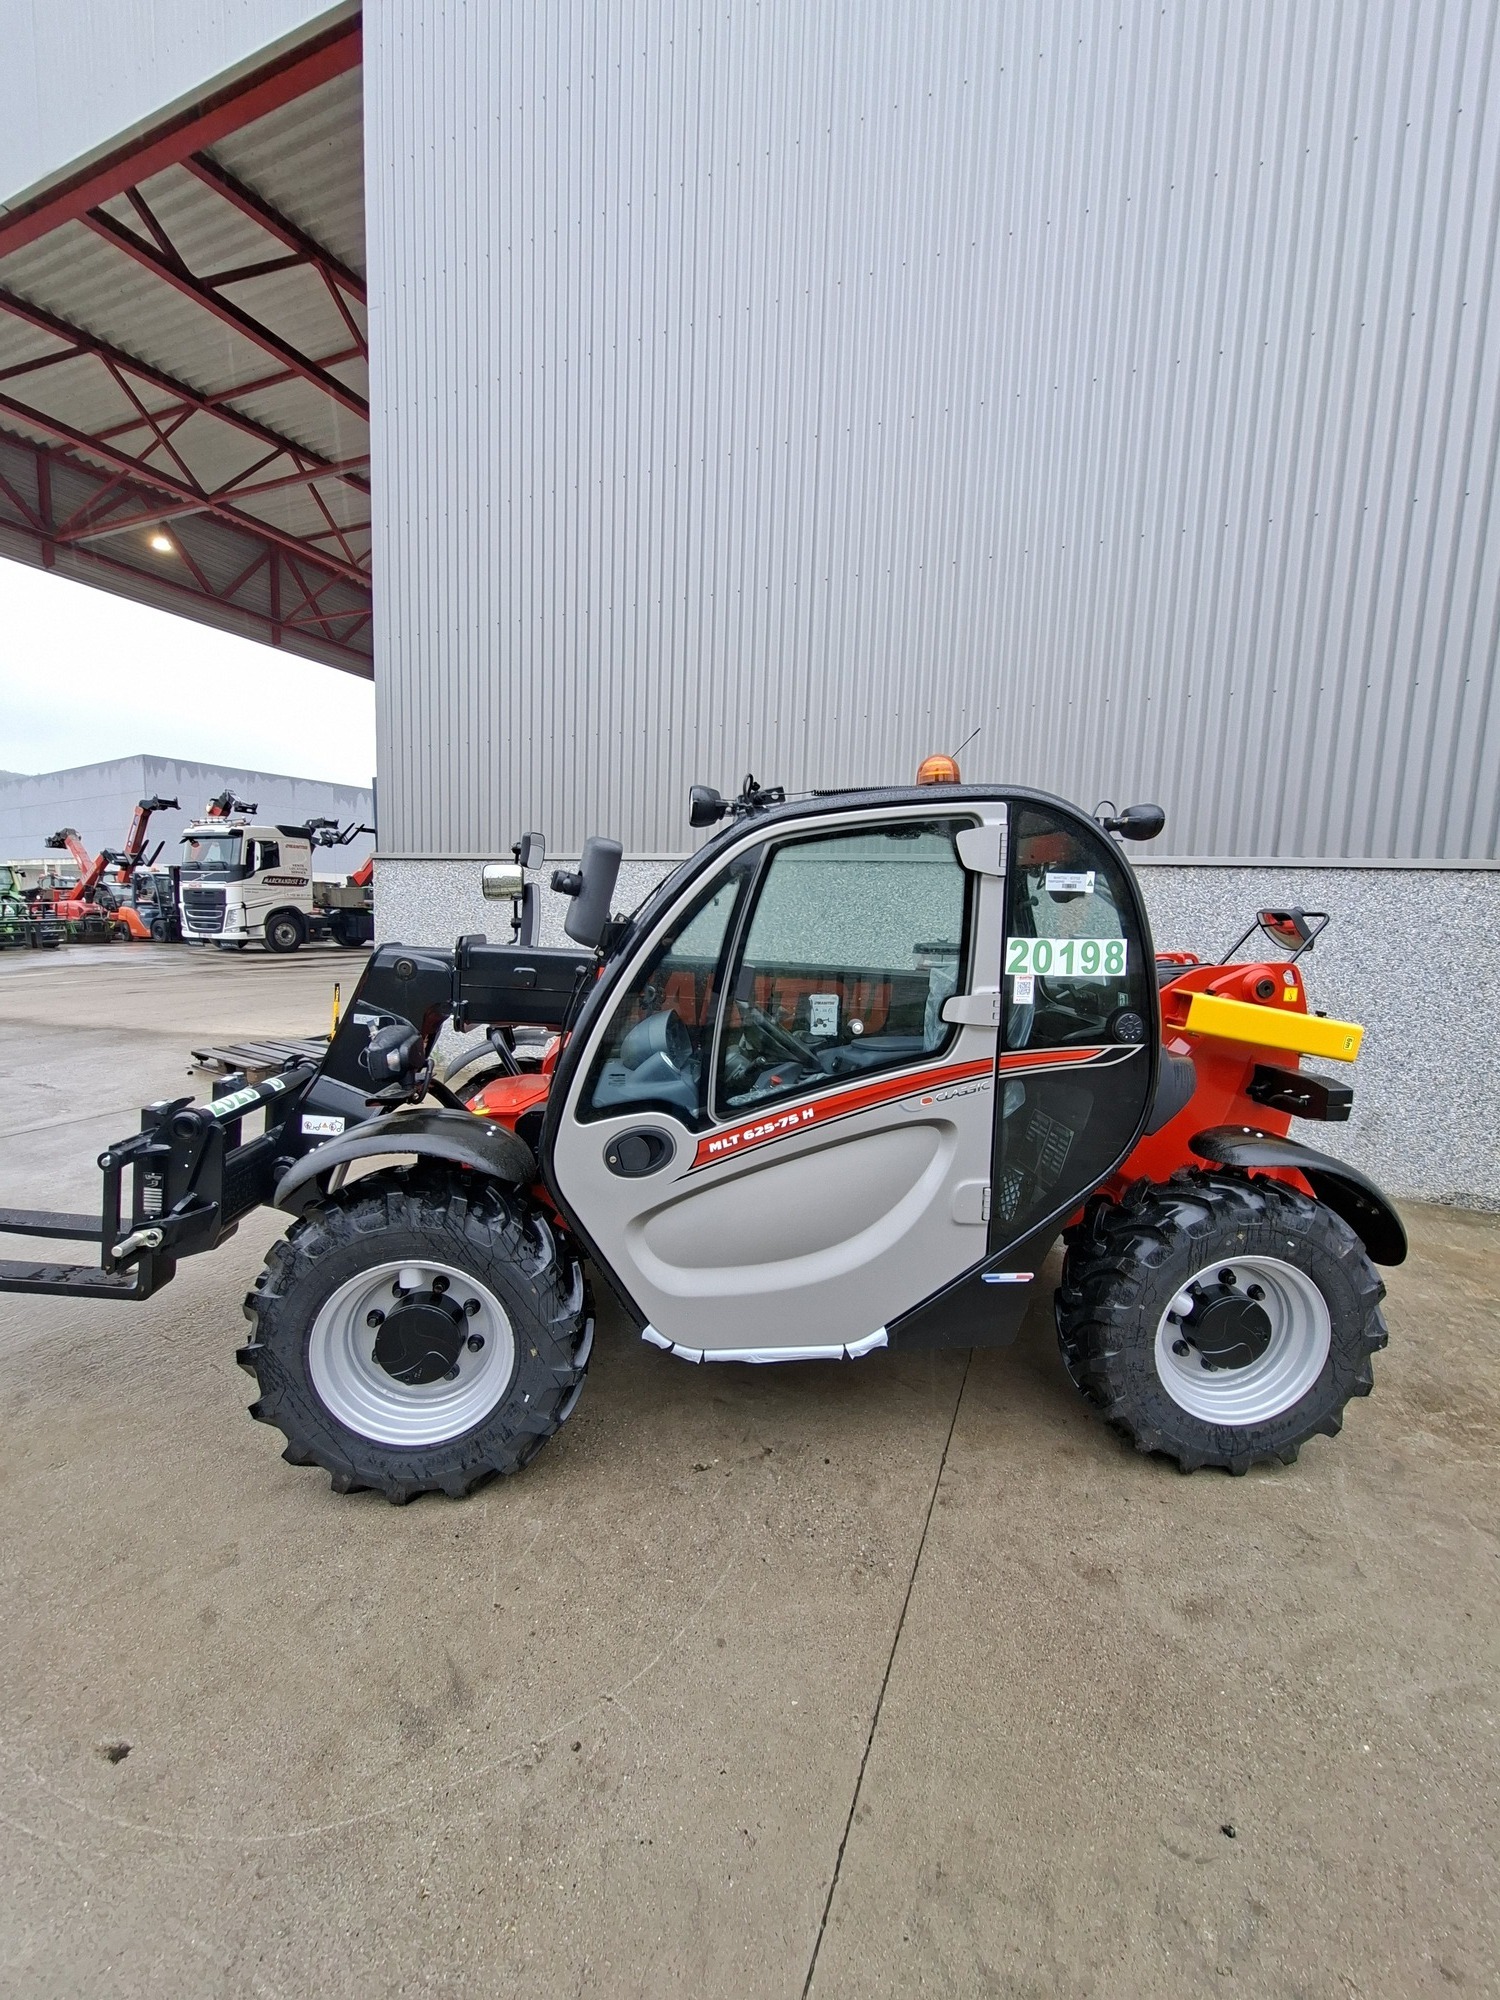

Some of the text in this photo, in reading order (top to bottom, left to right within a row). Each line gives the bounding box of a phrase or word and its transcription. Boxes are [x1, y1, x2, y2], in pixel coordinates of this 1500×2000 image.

[263, 877, 298, 885] MARCHANDISE
[1007, 939, 1124, 974] 20198
[935, 1081, 990, 1102] CLASSIC
[709, 1108, 814, 1153] MLT 625-75 H
